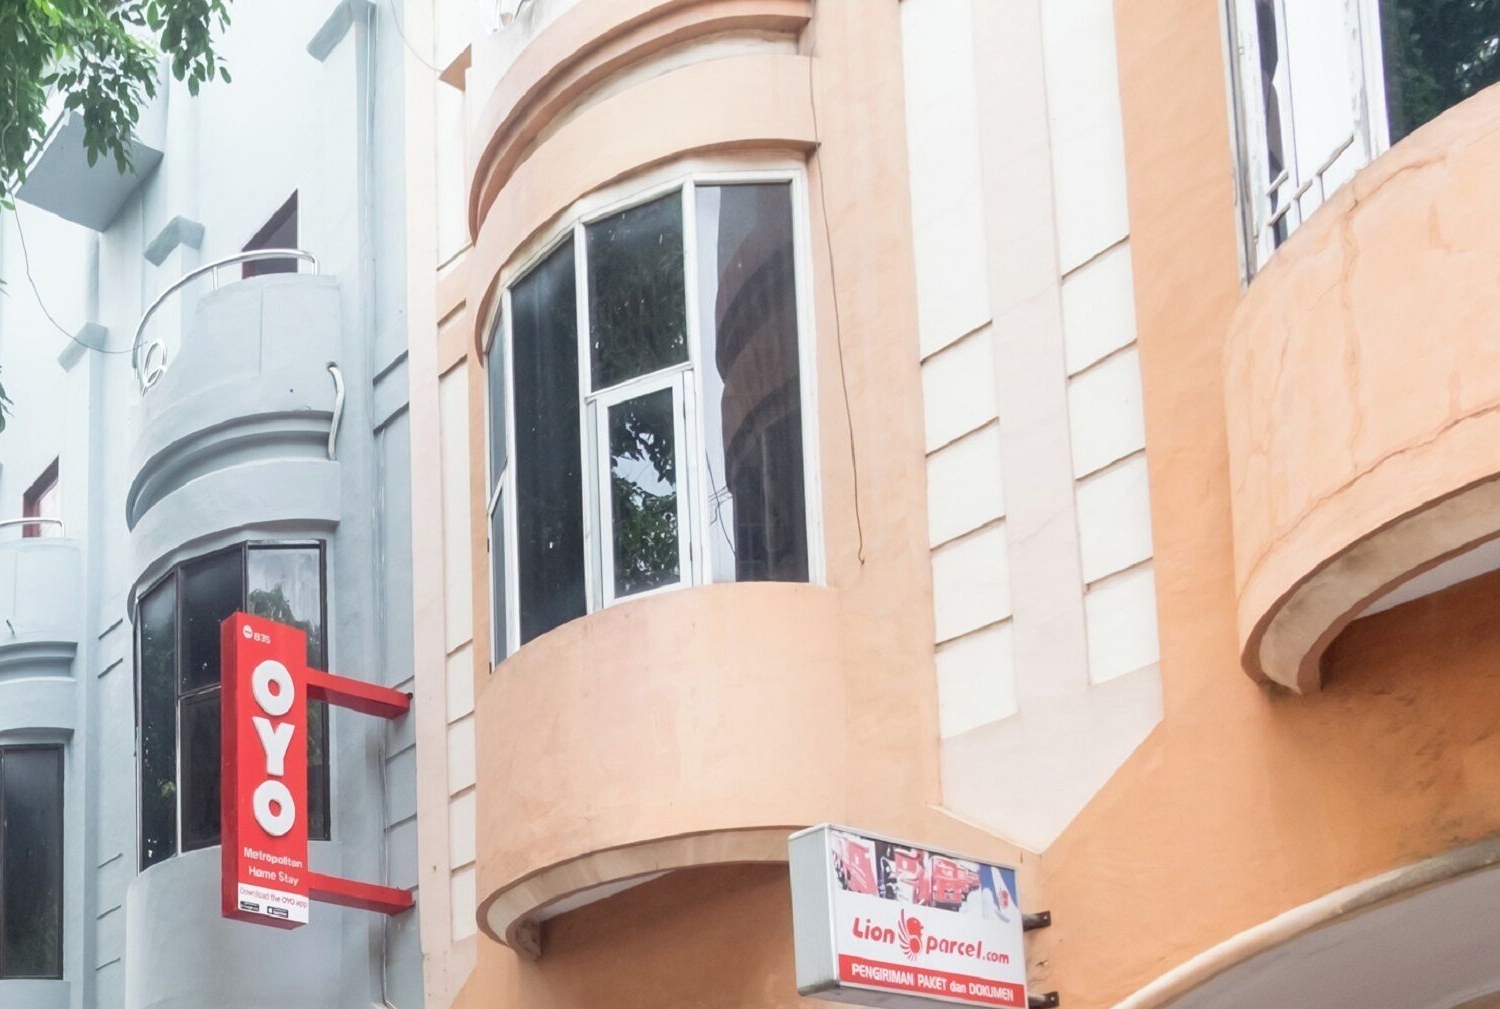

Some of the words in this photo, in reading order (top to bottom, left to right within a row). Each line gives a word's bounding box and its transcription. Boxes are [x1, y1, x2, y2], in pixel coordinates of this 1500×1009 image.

[251, 659, 296, 837] OYO
[243, 846, 303, 869] Metropolitan
[248, 865, 277, 881] Home
[278, 871, 299, 887] Stay
[240, 887, 269, 900] Download
[271, 894, 280, 902] the
[296, 901, 307, 909] app
[852, 917, 895, 944] Lion
[926, 935, 1009, 964] parcel.com
[851, 963, 914, 987] PENGIRIMAN
[917, 973, 947, 991] PAKET
[950, 981, 966, 994] dan
[969, 983, 1013, 1001] DOKUMEN
